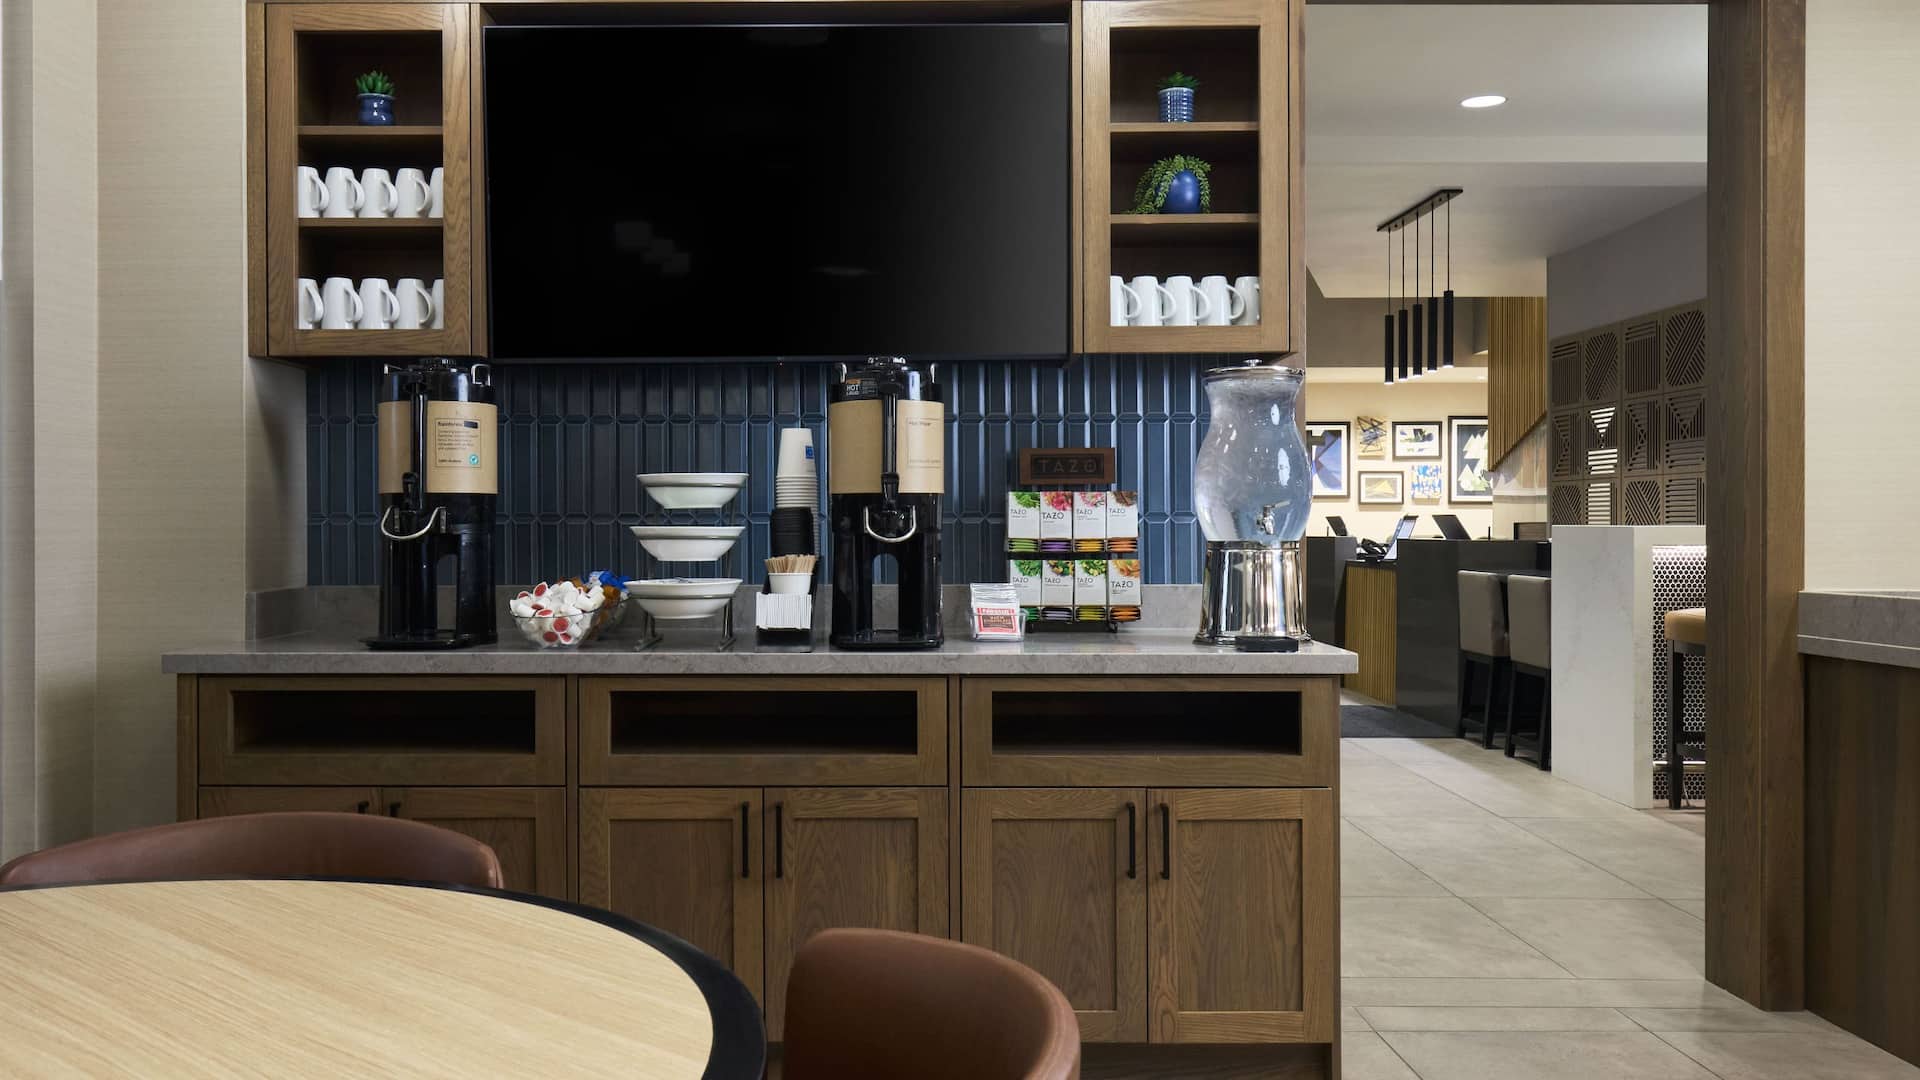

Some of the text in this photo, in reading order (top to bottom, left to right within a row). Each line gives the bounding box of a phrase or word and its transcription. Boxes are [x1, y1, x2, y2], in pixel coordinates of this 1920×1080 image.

[1040, 459, 1097, 473] TAZO
[1042, 512, 1064, 520] TAZO
[1111, 580, 1134, 589] TAZO
